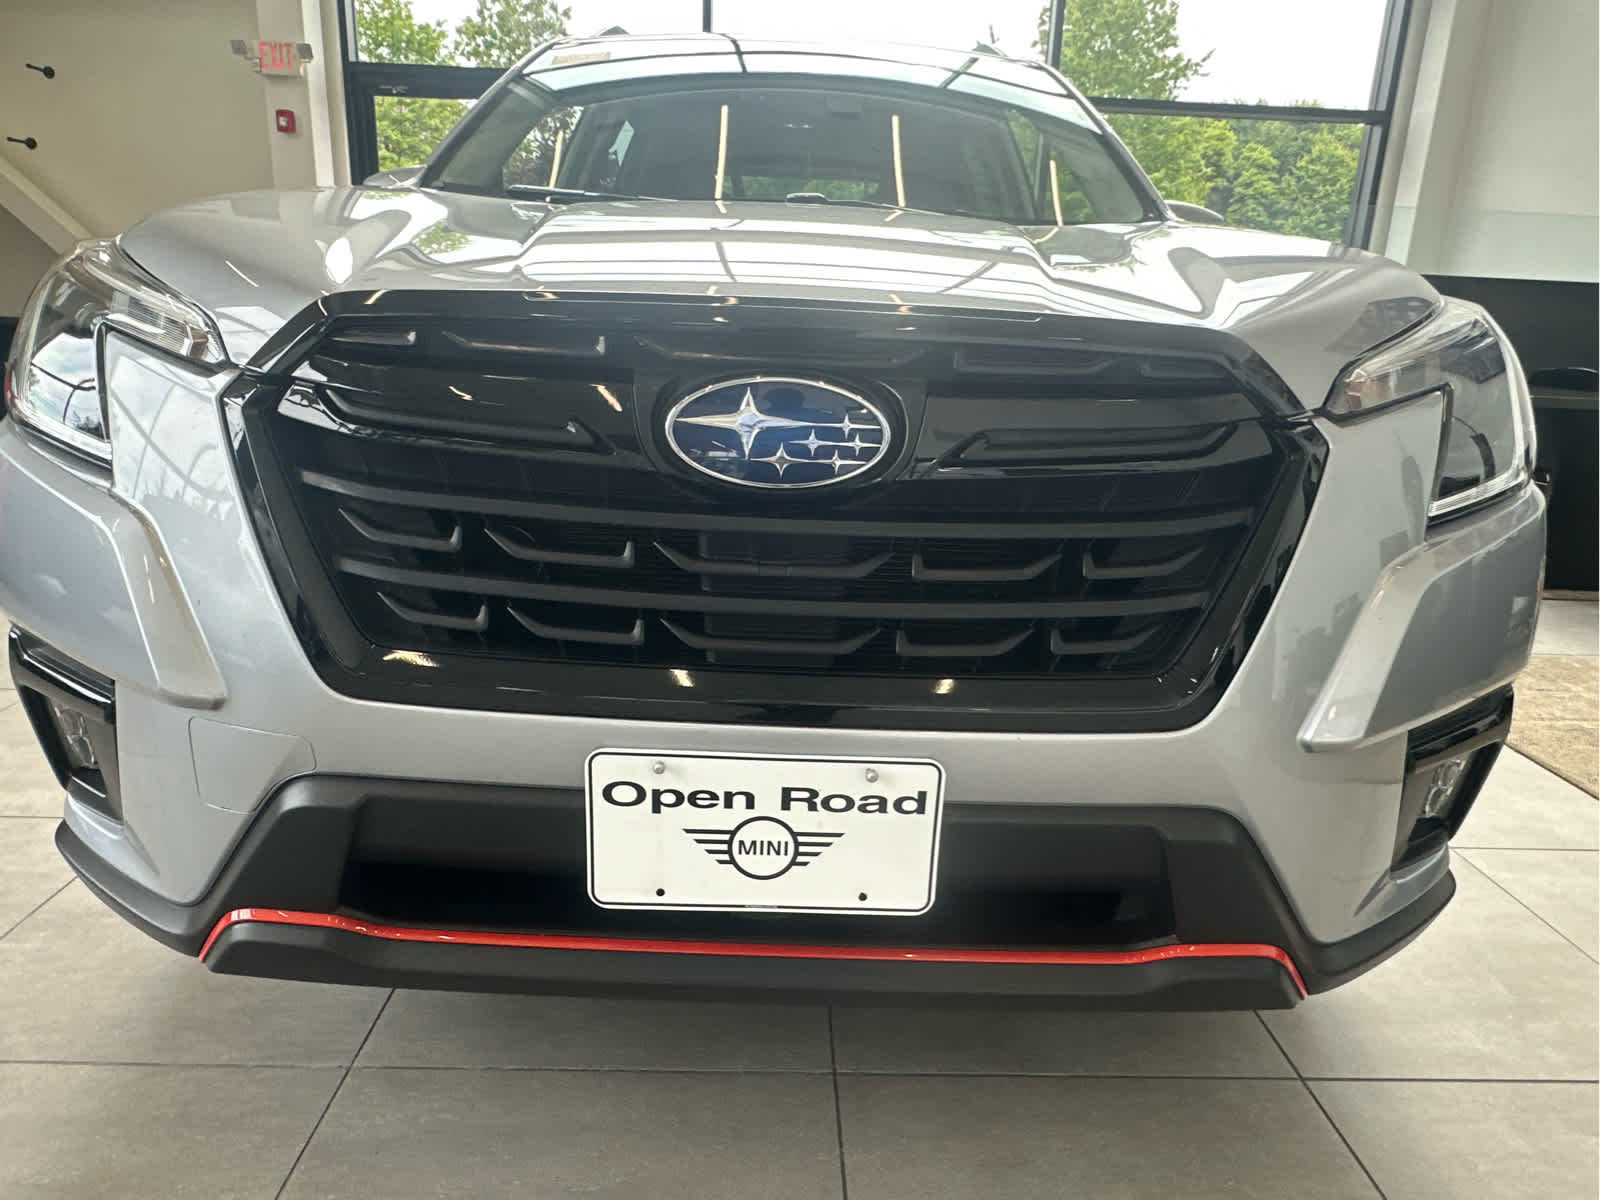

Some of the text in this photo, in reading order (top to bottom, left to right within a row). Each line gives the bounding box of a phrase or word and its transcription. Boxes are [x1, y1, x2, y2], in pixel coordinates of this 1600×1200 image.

[258, 41, 293, 70] EXIT
[602, 780, 928, 815] Open Road
[738, 839, 790, 856] MINI
